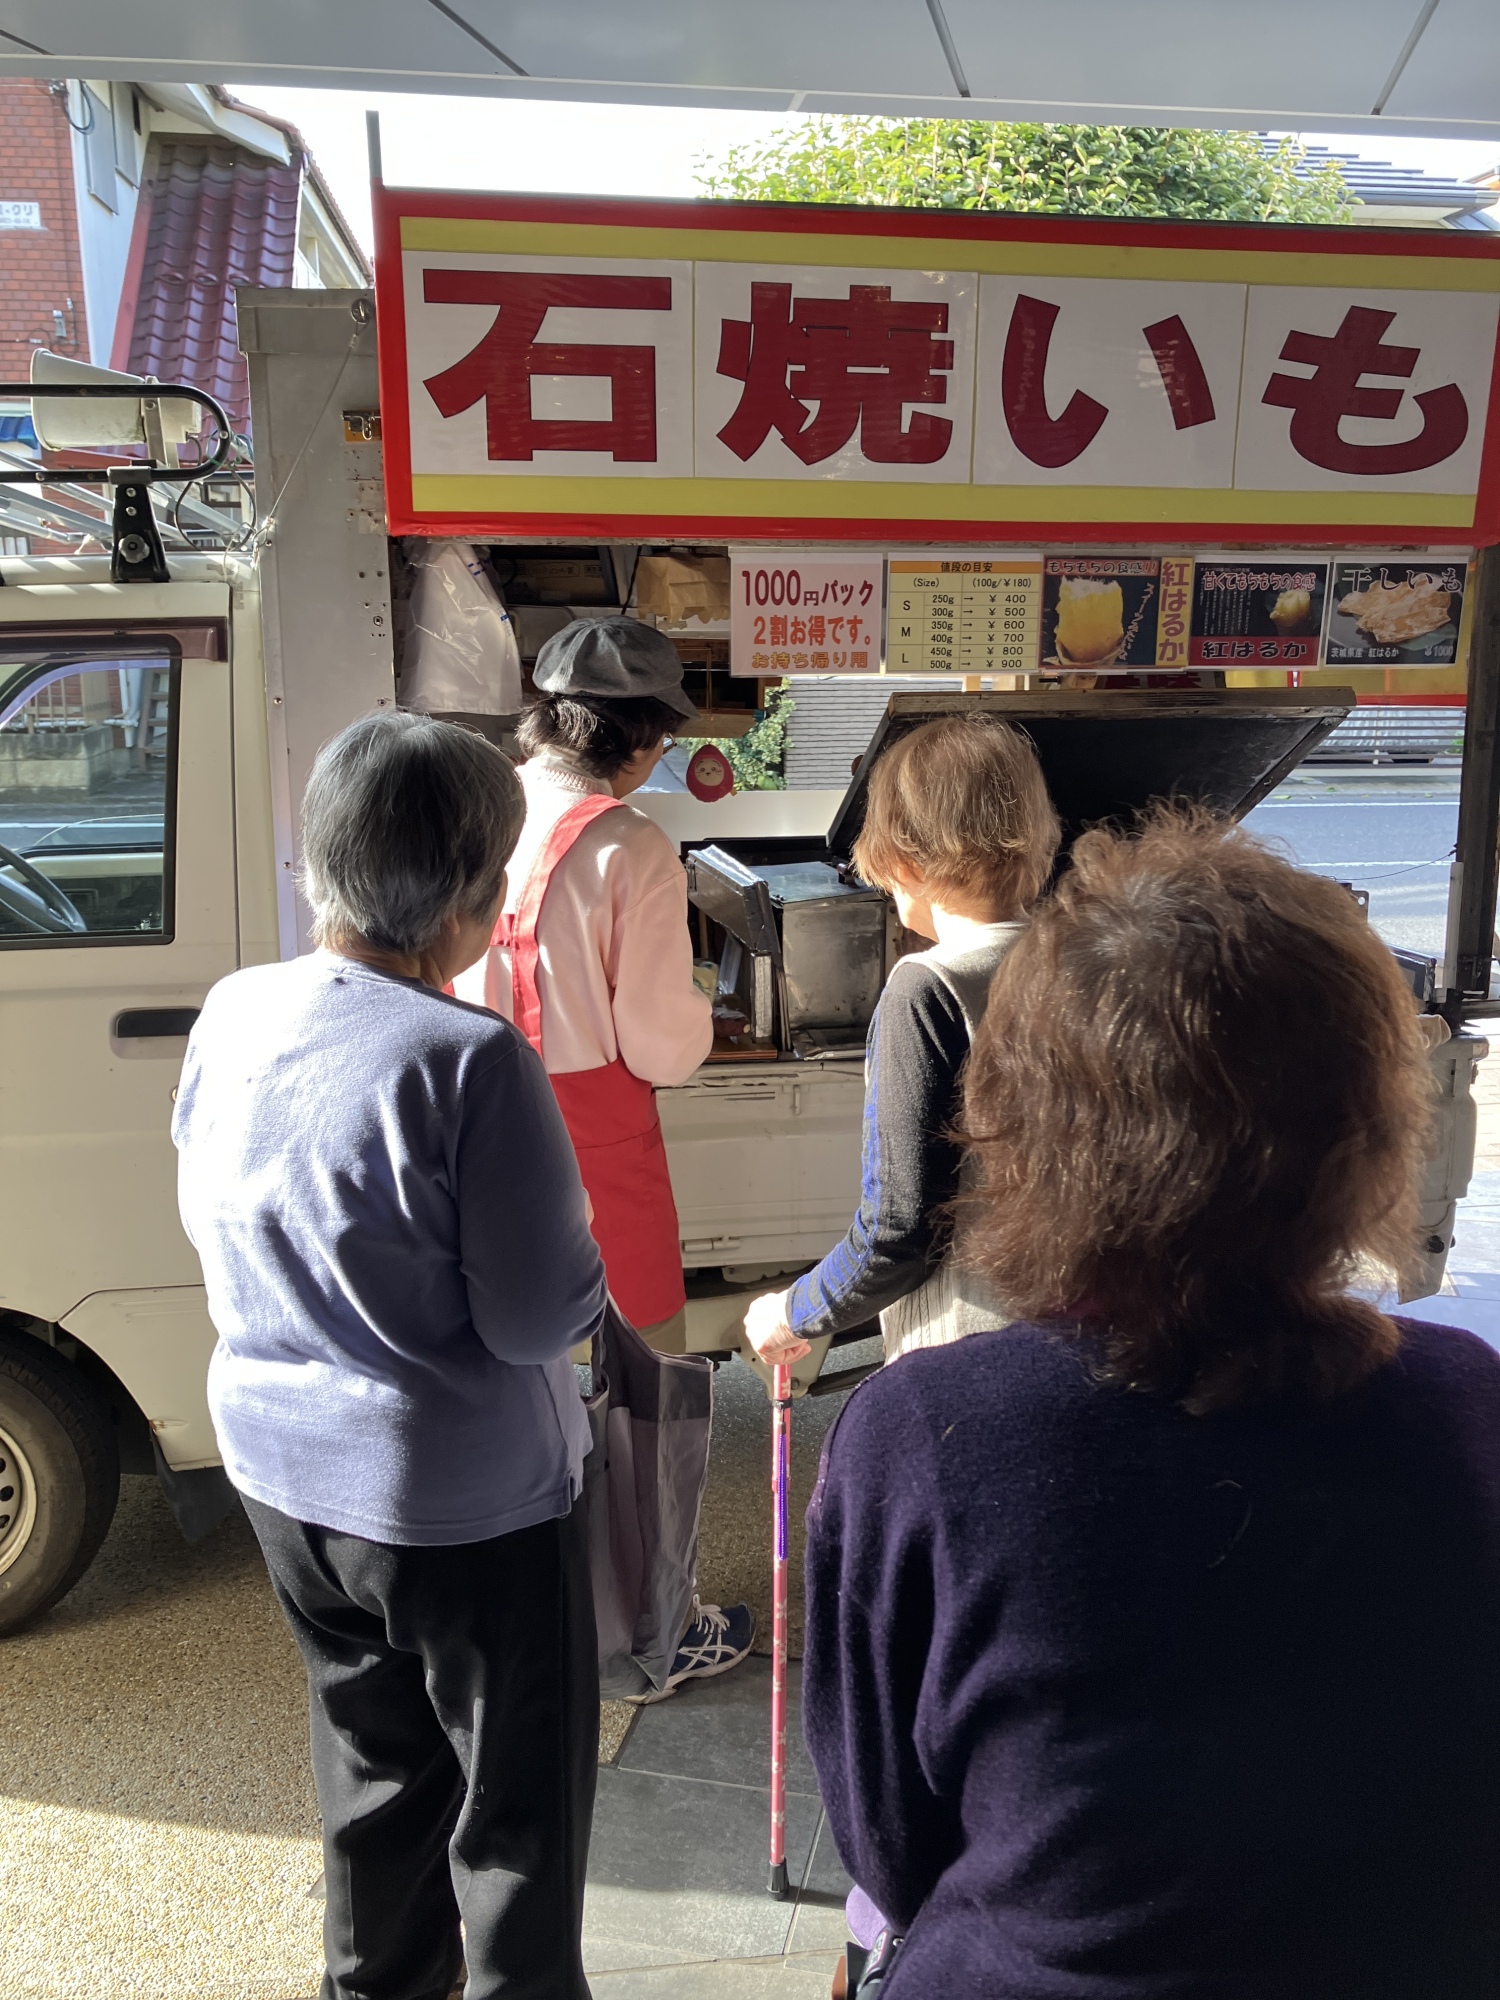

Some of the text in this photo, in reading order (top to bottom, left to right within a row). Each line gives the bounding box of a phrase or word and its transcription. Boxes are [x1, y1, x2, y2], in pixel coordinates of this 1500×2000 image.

[423, 269, 1469, 476] 石焼いも
[941, 562, 993, 573] 値段の目安
[913, 577, 940, 588] (Size)
[1203, 571, 1316, 591] 甘くてもちもちの食感
[1342, 567, 1462, 592] 干しいも
[742, 570, 873, 606] 1000円パック
[903, 600, 911, 611] S
[932, 595, 954, 605] 250g
[1005, 595, 1026, 603] 400
[931, 608, 954, 617] 300g
[1004, 608, 1026, 616] 500
[1158, 561, 1190, 662] 紅はるか
[754, 615, 871, 646] 2割お得です。
[931, 621, 953, 631] 350g
[1003, 621, 1025, 629] 600
[901, 627, 911, 637] M
[930, 634, 953, 644] 400g
[1003, 634, 1024, 642] 700
[930, 647, 953, 657] 450g
[1002, 647, 1023, 655] 800
[1202, 641, 1307, 659] 紅はるか
[1368, 647, 1399, 658] 紅はるか
[752, 652, 868, 669] お持ち帰り用
[902, 653, 909, 664] L
[930, 660, 952, 669] 500g
[1001, 660, 1022, 668] 900
